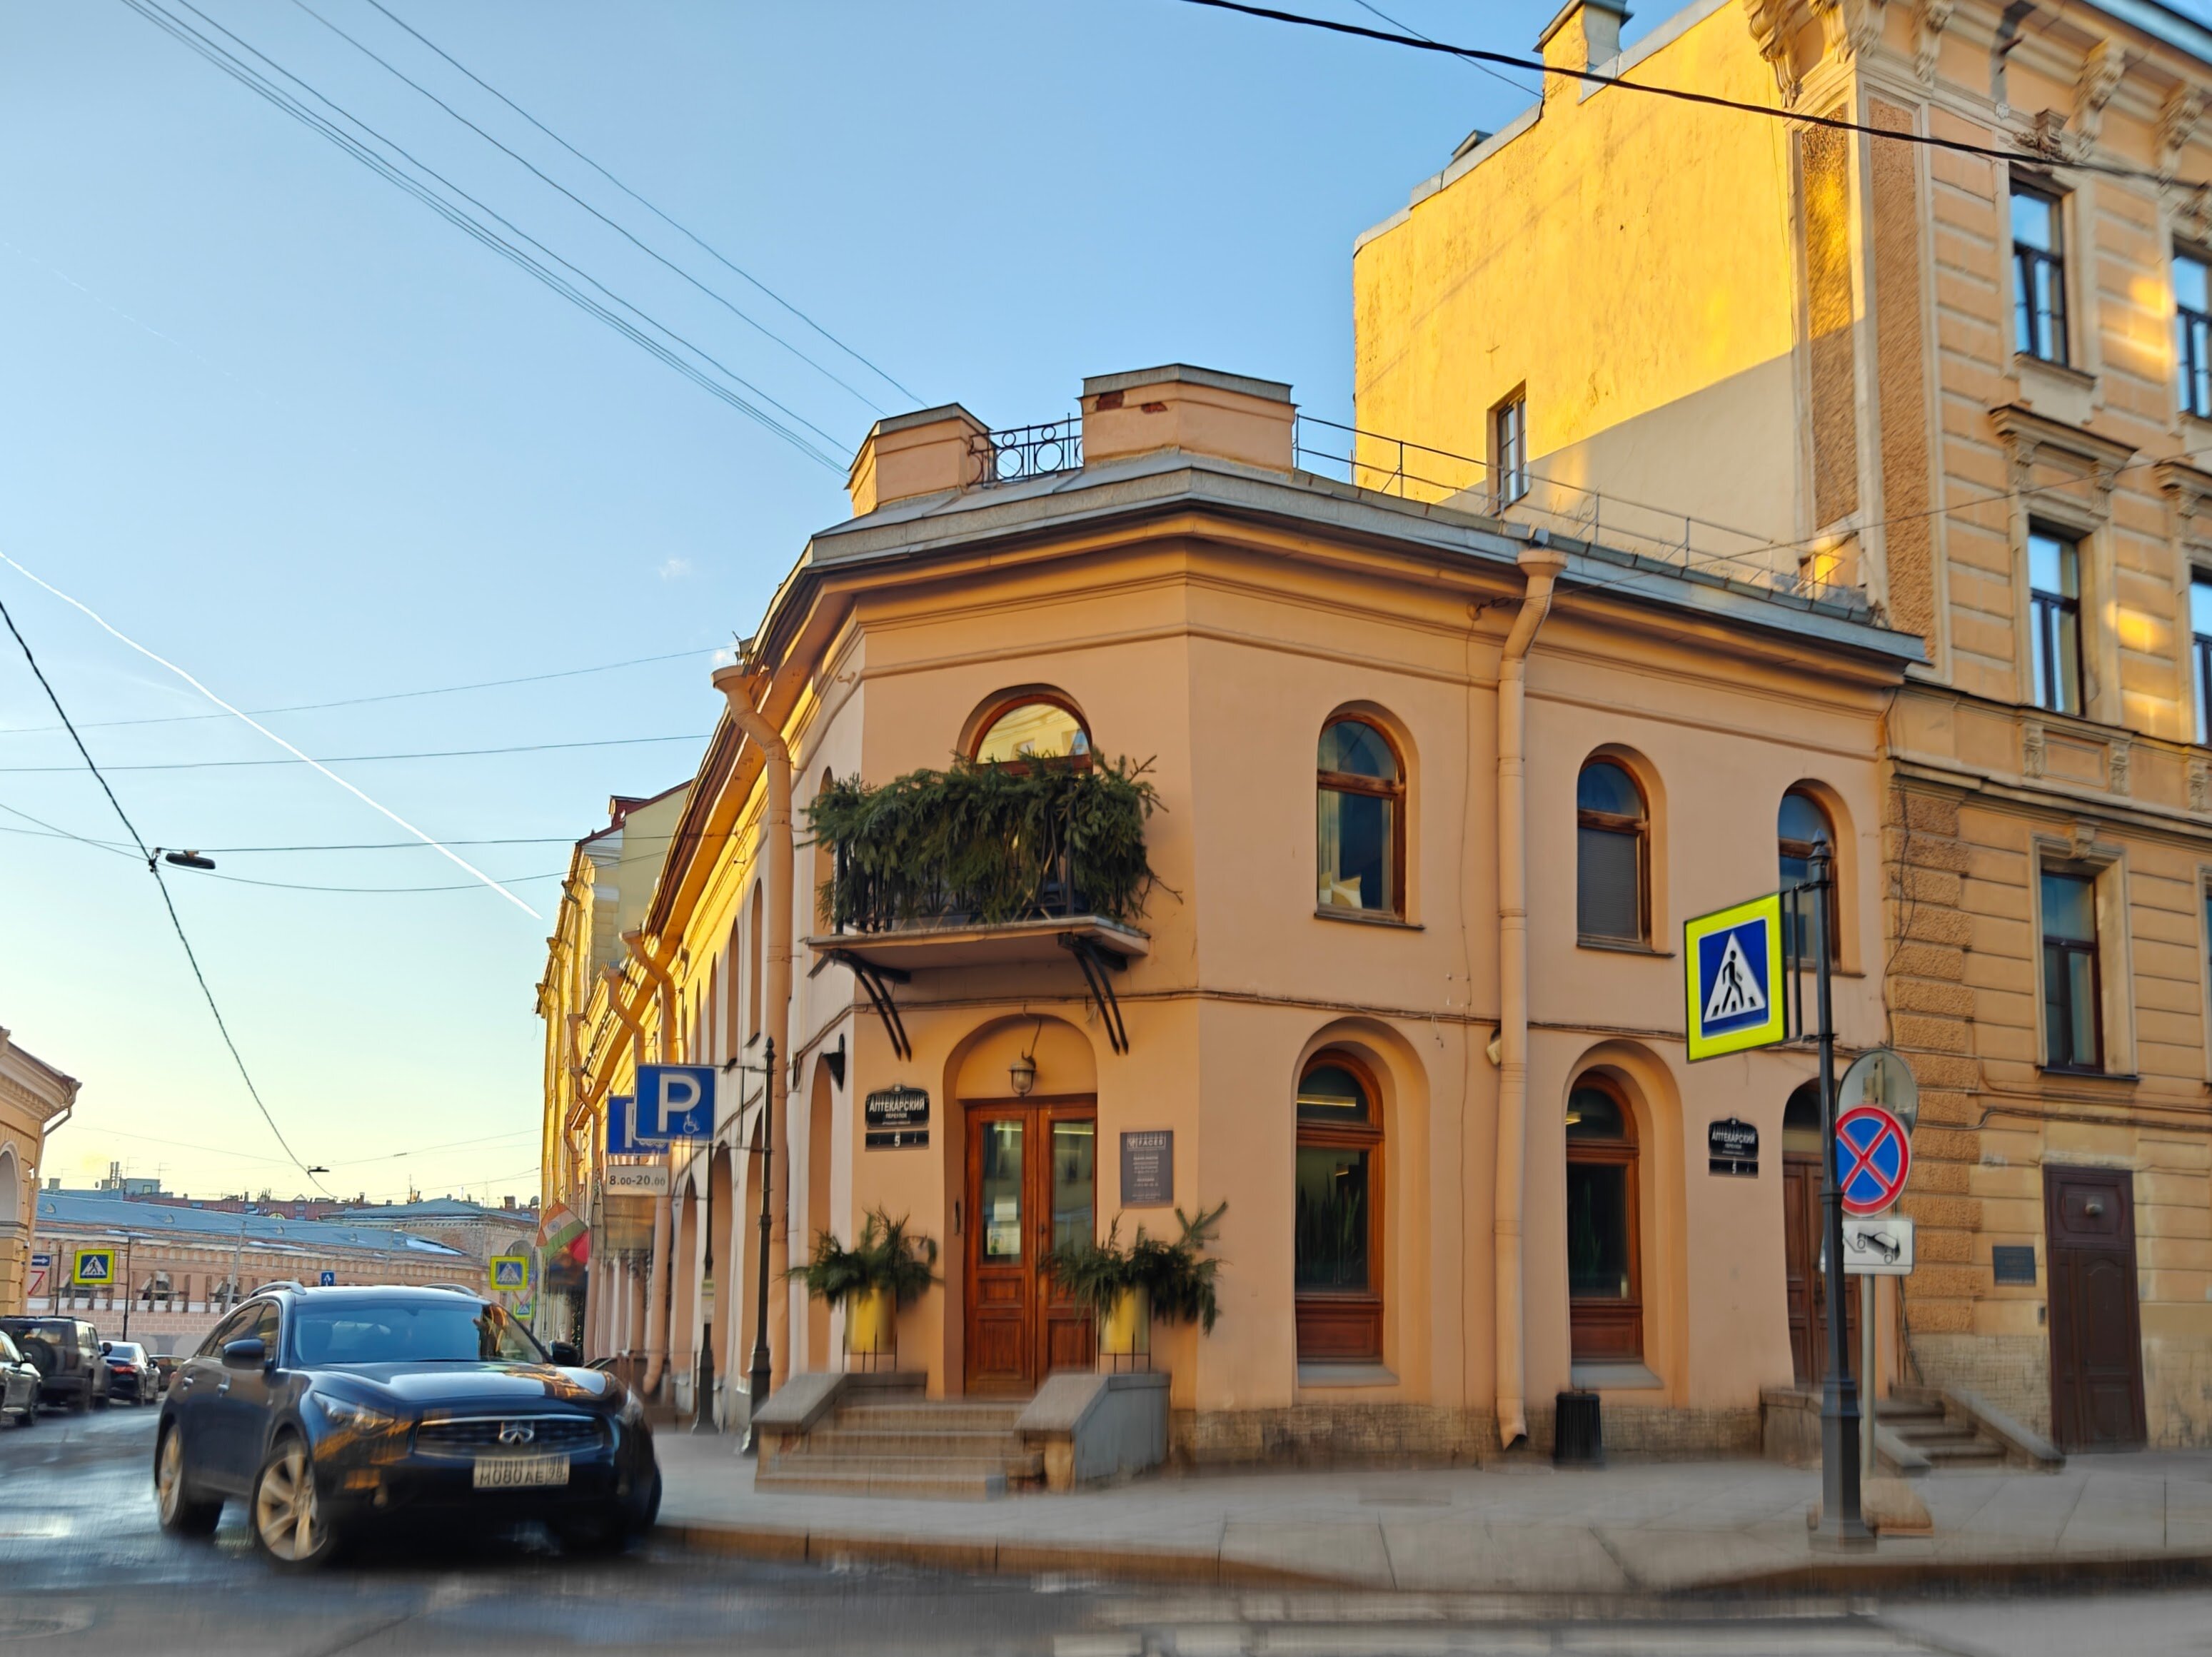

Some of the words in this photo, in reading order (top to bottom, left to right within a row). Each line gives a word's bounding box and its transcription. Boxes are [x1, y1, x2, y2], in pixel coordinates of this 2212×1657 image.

[658, 1073, 701, 1132] P
[869, 1099, 925, 1112] АПТЕКАРСКИЙ
[894, 1134, 901, 1147] 5
[1711, 1131, 1756, 1144] АПТЕКАРСКИЙ
[610, 1175, 665, 1186] 8.00-20.00
